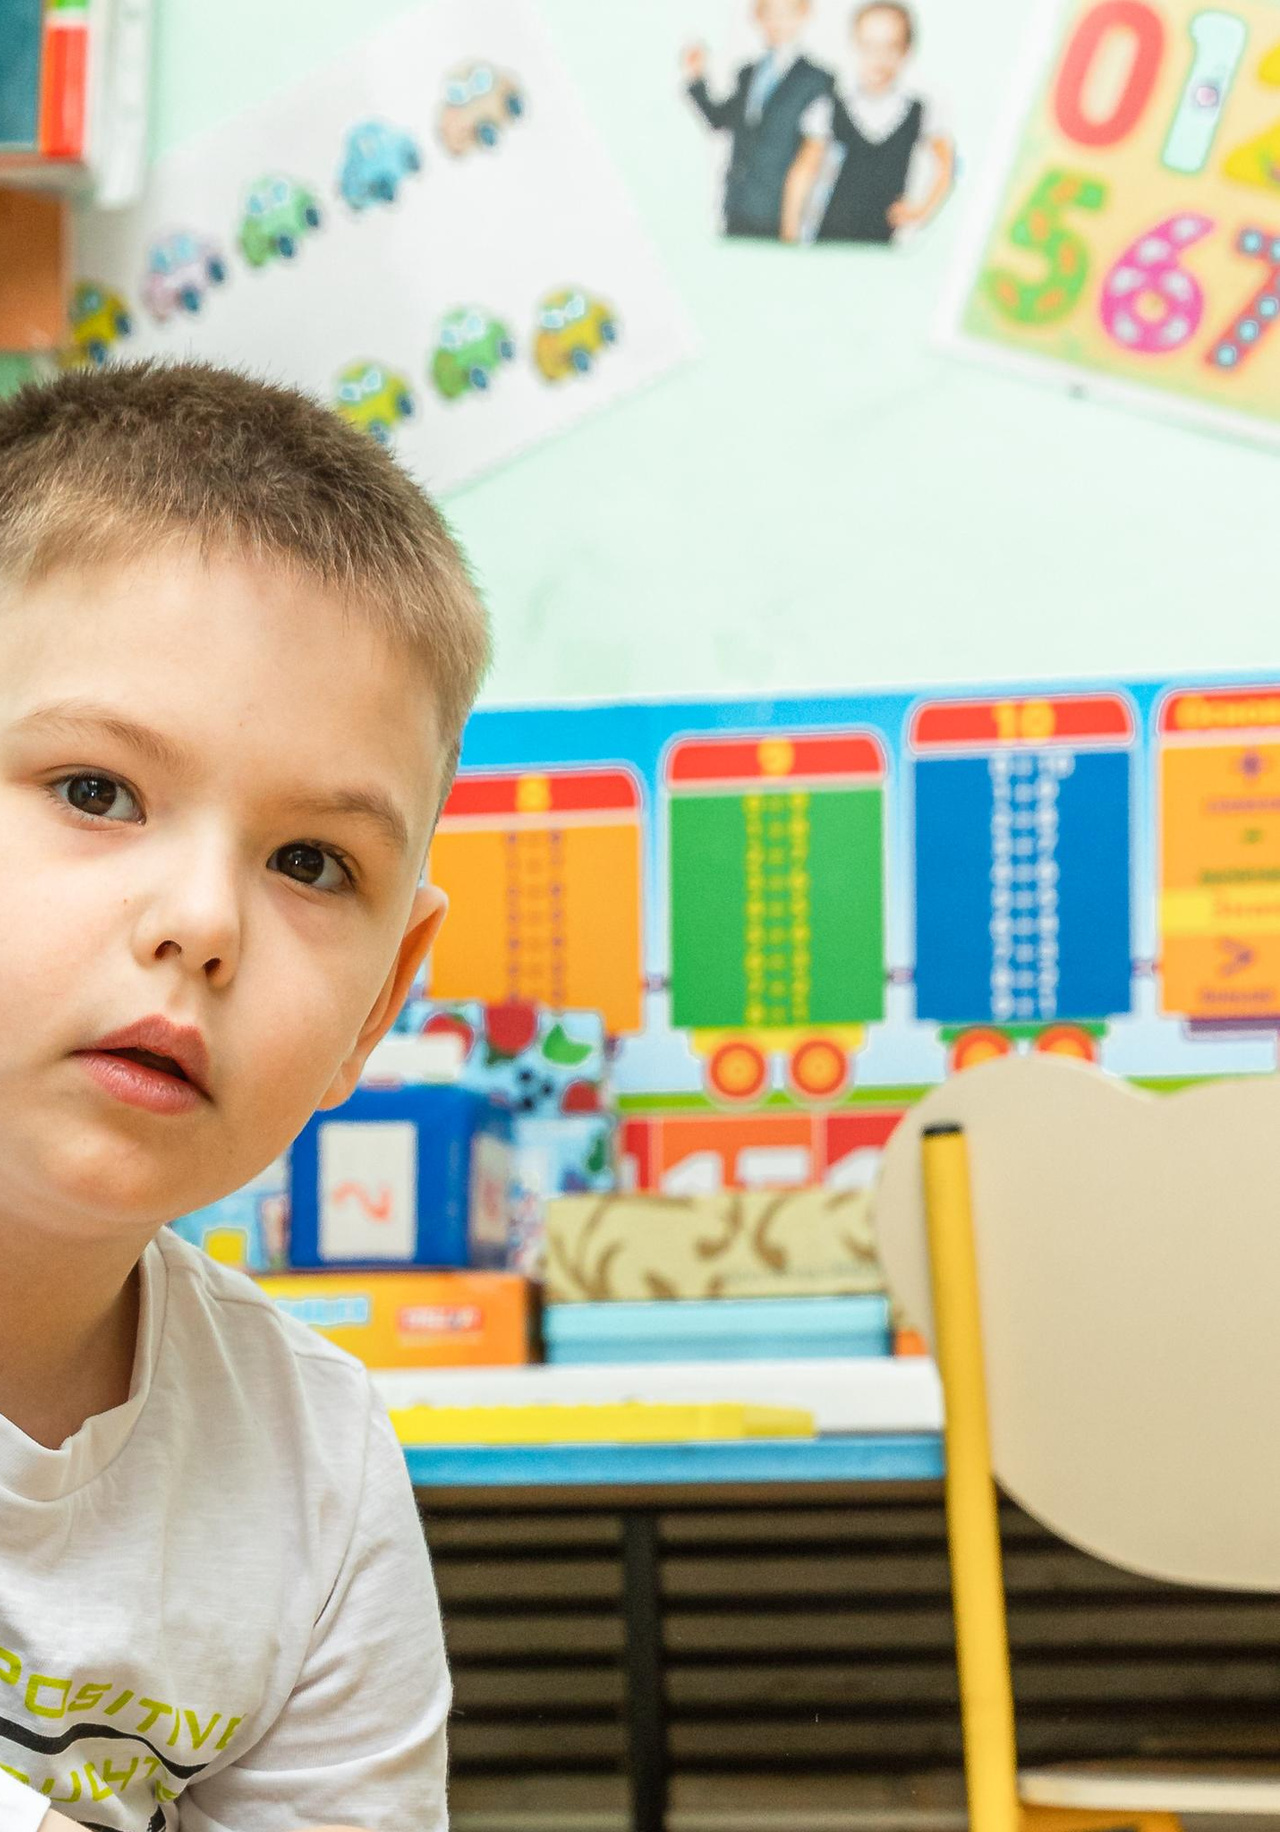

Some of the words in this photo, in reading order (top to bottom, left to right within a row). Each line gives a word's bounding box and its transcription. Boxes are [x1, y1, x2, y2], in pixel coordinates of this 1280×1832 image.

[1052, 0, 1165, 148] 0
[1161, 9, 1247, 174] 1
[983, 167, 1108, 325] 5
[1099, 210, 1216, 354] 6
